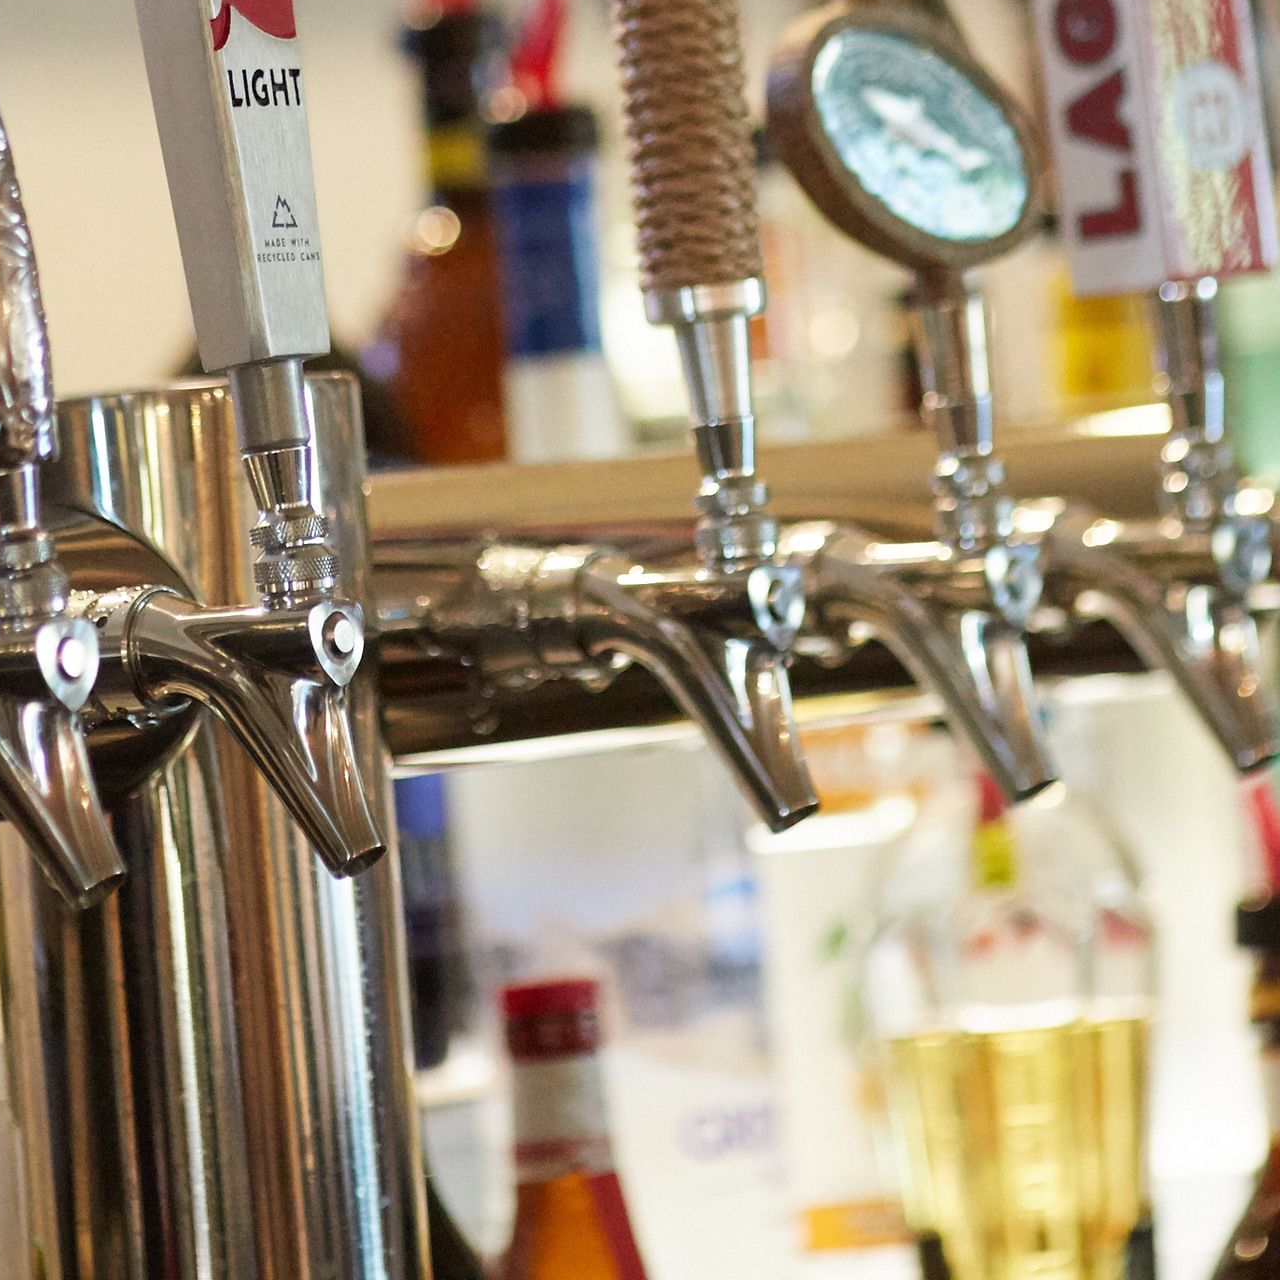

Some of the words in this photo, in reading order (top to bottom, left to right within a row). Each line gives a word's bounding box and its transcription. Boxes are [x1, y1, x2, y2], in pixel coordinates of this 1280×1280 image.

[227, 67, 302, 108] LIGHT
[264, 238, 286, 248] MADE
[291, 238, 310, 248] WITH
[256, 251, 296, 264] RECYCLED
[300, 251, 320, 262] CANS
